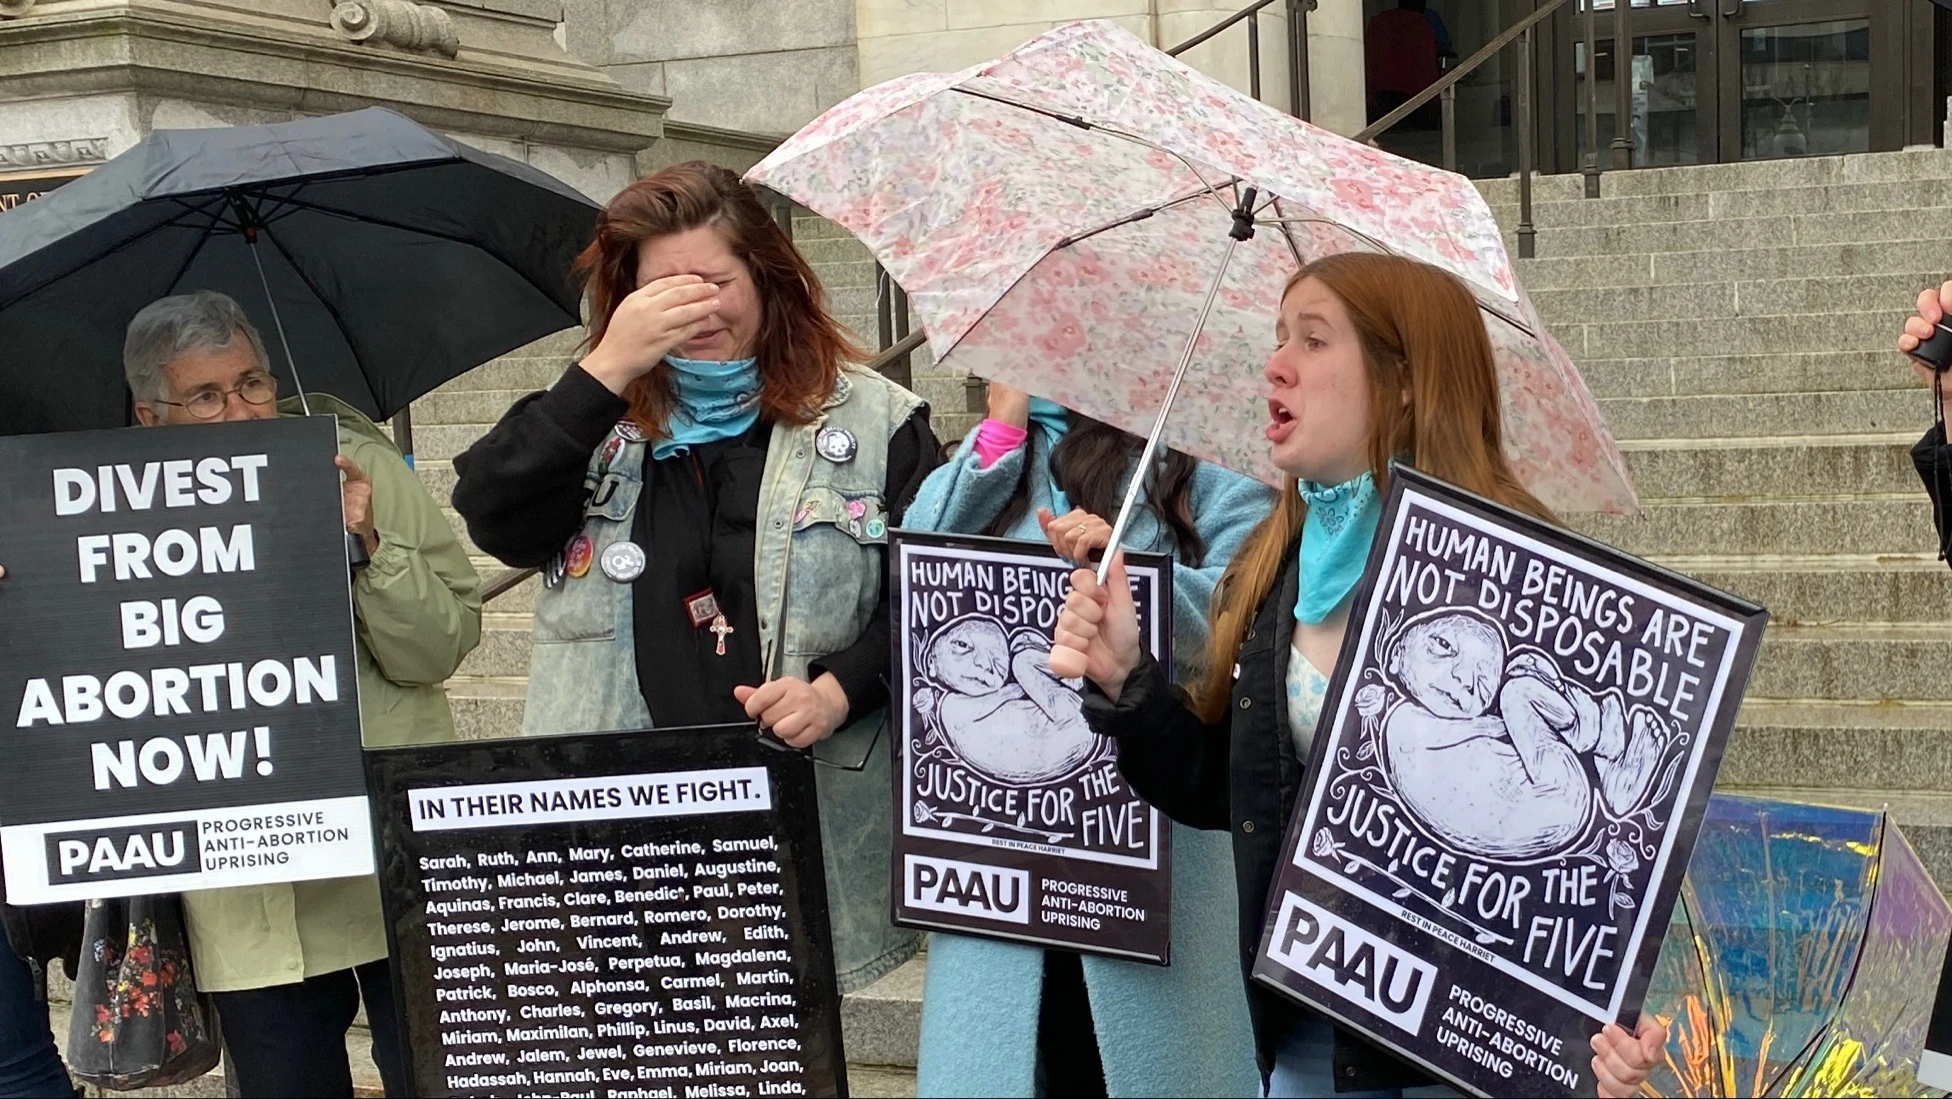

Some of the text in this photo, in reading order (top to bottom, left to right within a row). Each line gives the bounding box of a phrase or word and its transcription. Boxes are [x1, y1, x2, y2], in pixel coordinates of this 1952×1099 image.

[54, 455, 267, 515] DIVEST
[78, 524, 255, 582] FROM
[912, 562, 1074, 597] HUMAN BEING
[1406, 516, 1714, 668] HUMAN BEINGS ARE
[121, 596, 224, 648] BIG
[912, 591, 962, 627] NOT
[1386, 555, 1700, 723] NOT DISPOSABLE
[17, 655, 338, 727] ABORTION
[92, 727, 273, 789] NOW!
[419, 779, 760, 819] IN THEIR NAMES WE FIGHT.
[917, 763, 1119, 825] JUSTICE FOR THE
[203, 812, 323, 834] PROGRESSIVE
[205, 828, 348, 852] ANTI-ABORTION
[1082, 801, 1143, 848] FIVE
[59, 831, 184, 875] PAAU
[206, 852, 289, 870] UPRISING
[419, 835, 779, 871] Sarah, Ruth, Ann, Mary, Catherine, Samuel,
[1326, 785, 1597, 928] JUSTICE FOR THE
[420, 858, 781, 893] Timothy, Michael, James, Daniel, Augustine,
[914, 864, 1019, 913] PAAU
[1042, 878, 1128, 902] PROGRESSIVE
[425, 897, 496, 918] Aquinas,
[498, 892, 561, 910] Francis,
[563, 891, 611, 906] Clare,
[692, 882, 734, 899] Paul,
[737, 881, 784, 896] Peter,
[1041, 895, 1145, 921] ANTI-ABORTION
[426, 903, 787, 936] Therese, Jerome, Bernard, Romero, Dorothy,
[1041, 911, 1101, 930] UPRISING
[1401, 910, 1496, 963] REST IN PEACE HARRIET
[430, 924, 789, 962] Ignatius, John, Vincent, Andrew, Edith,
[1280, 904, 1424, 1014] PAAU
[1524, 916, 1617, 989] FIVE
[433, 948, 792, 982] Joseph, Maria-José, Perpetua, Magdalena,
[435, 968, 794, 1002] Patrick, Bosco, Alphonsa, Carmel, Martin,
[439, 991, 797, 1025] Anthony, Charles, Gregory, Basil, Macrina,
[1449, 984, 1563, 1056] PROGRESSIVE
[441, 1029, 503, 1046] Miriam,
[596, 1020, 650, 1040] Phillip,
[653, 1019, 700, 1035] Linus,
[703, 1015, 756, 1032] David,
[759, 1013, 799, 1029] Axel,
[1442, 1007, 1579, 1090] ANTI-ABORTION
[444, 1051, 510, 1067] Andrew,
[576, 1044, 627, 1061] Jewel,
[632, 1040, 722, 1057] Genevieve,
[728, 1038, 802, 1053] Florence,
[1436, 1026, 1514, 1078] UPRISING
[446, 1059, 804, 1089] Hadassah, Hannah, Eve, Emma, Miriam, Joan,
[685, 1083, 750, 1098] Melissa,
[758, 1080, 806, 1096] Linda,
